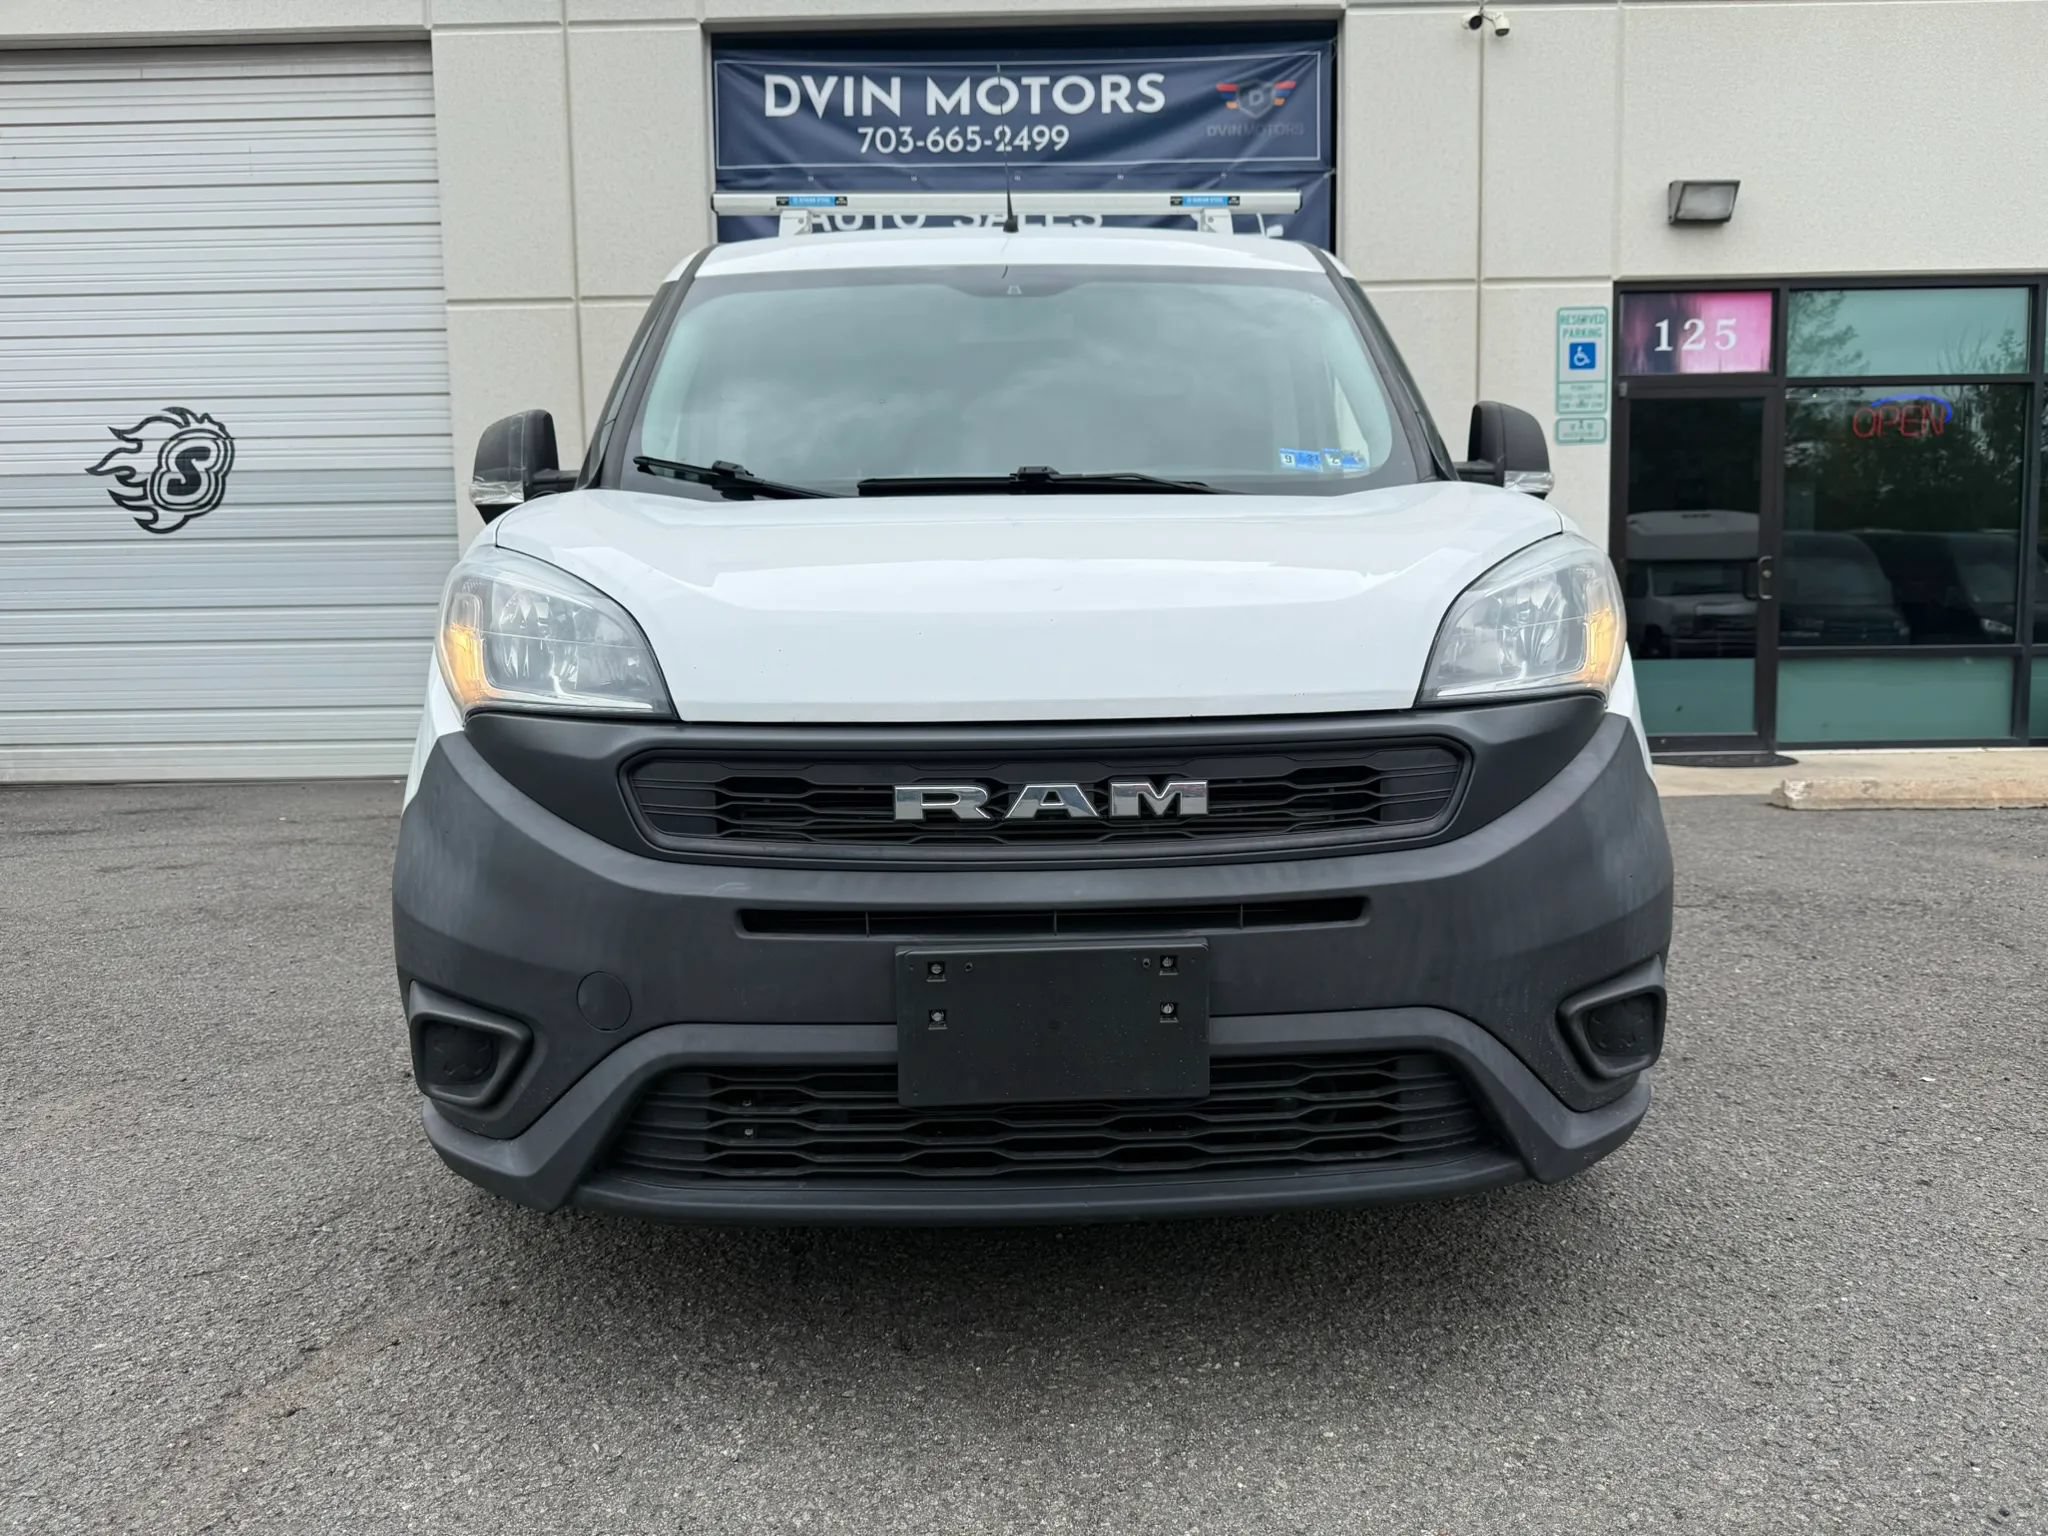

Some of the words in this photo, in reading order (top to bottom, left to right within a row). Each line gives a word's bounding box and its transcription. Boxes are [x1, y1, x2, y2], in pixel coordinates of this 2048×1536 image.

[764, 74, 901, 119] DVIN
[926, 73, 1166, 116] MOTORS
[857, 124, 1070, 153] 703-665-2499
[1206, 125, 1241, 137] DVIN
[1654, 318, 1737, 352] 125
[1852, 402, 1945, 439] OPEN
[894, 780, 1208, 822] RAM
